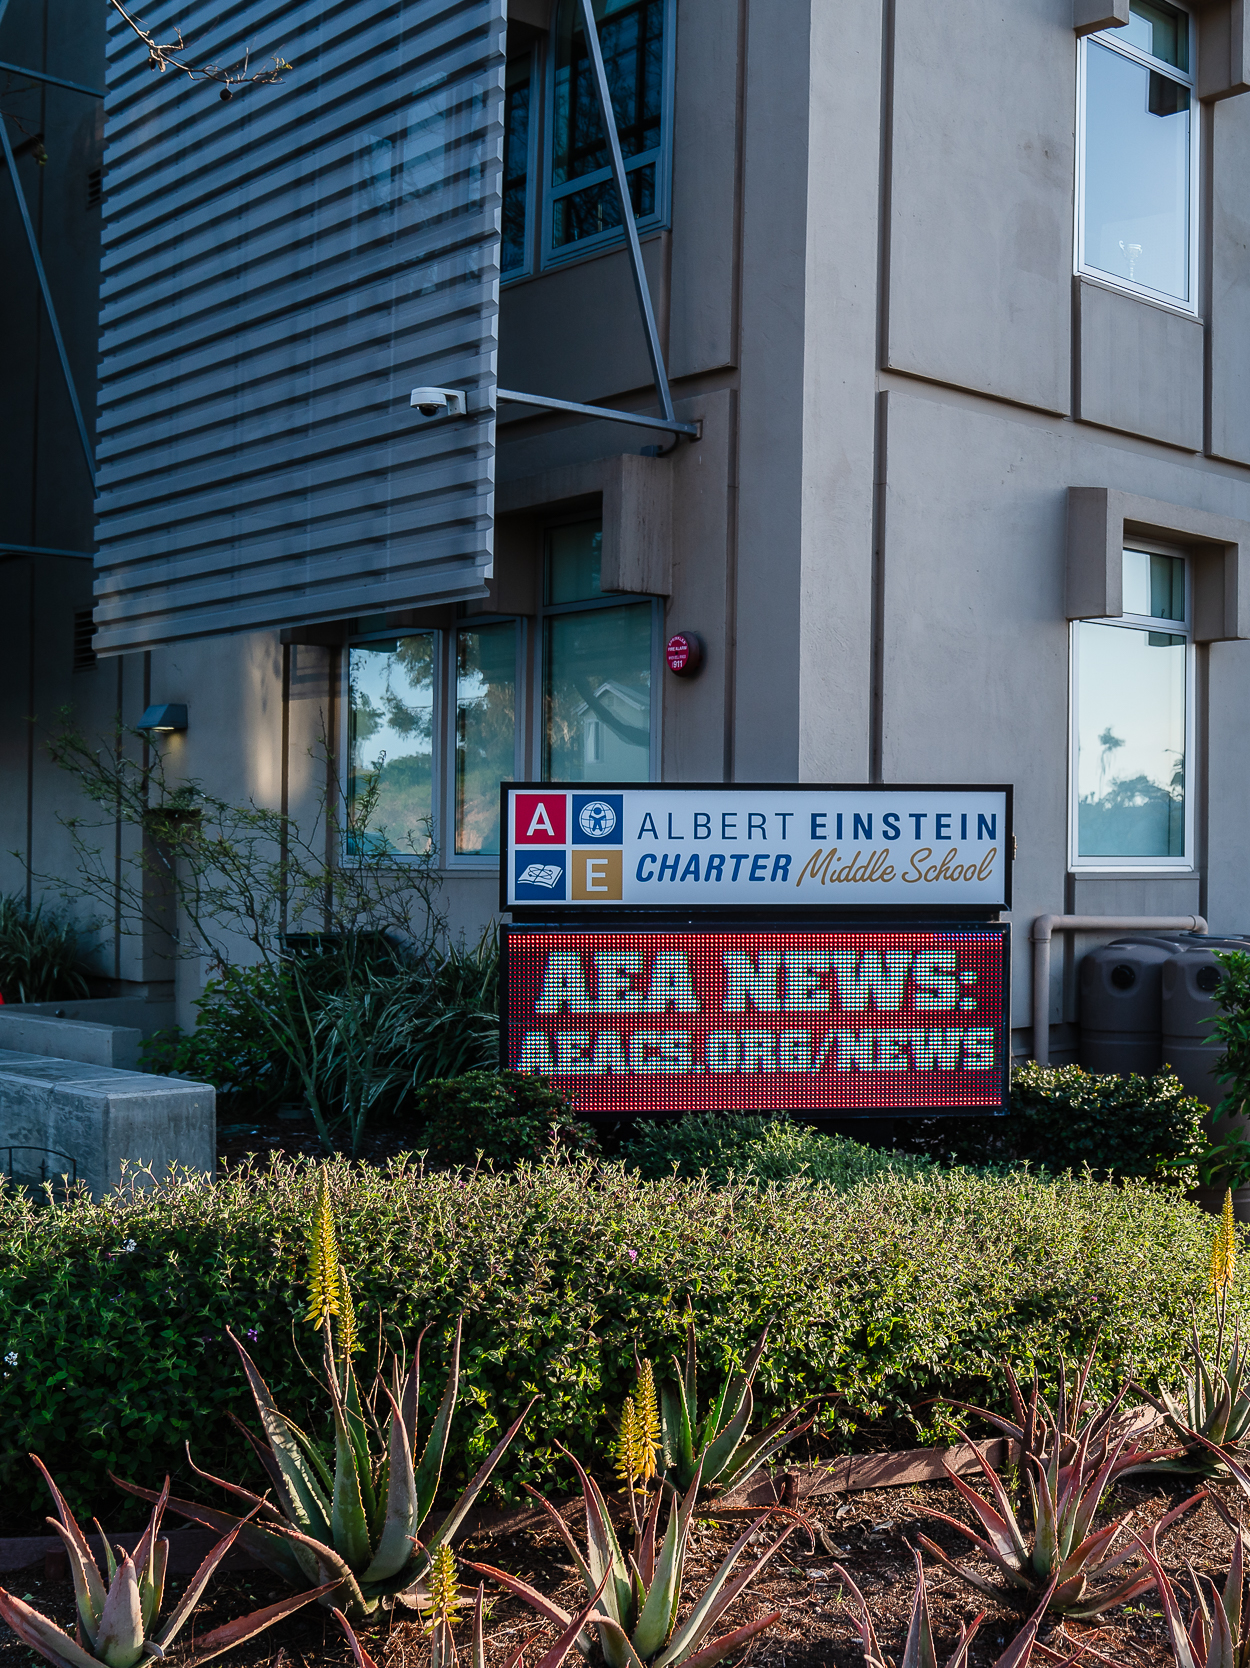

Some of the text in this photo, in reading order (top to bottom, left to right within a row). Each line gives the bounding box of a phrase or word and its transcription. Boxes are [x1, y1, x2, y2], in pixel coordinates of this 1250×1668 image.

[673, 660, 683, 668] 911
[526, 802, 555, 836] A
[637, 812, 997, 841] ALBERT EINSTEIN
[586, 858, 608, 892] E
[635, 847, 997, 887] CHARTER Middle School
[534, 950, 978, 1014] AEA NEWS:
[516, 1027, 995, 1076] AEACS.ORG/NEWS
